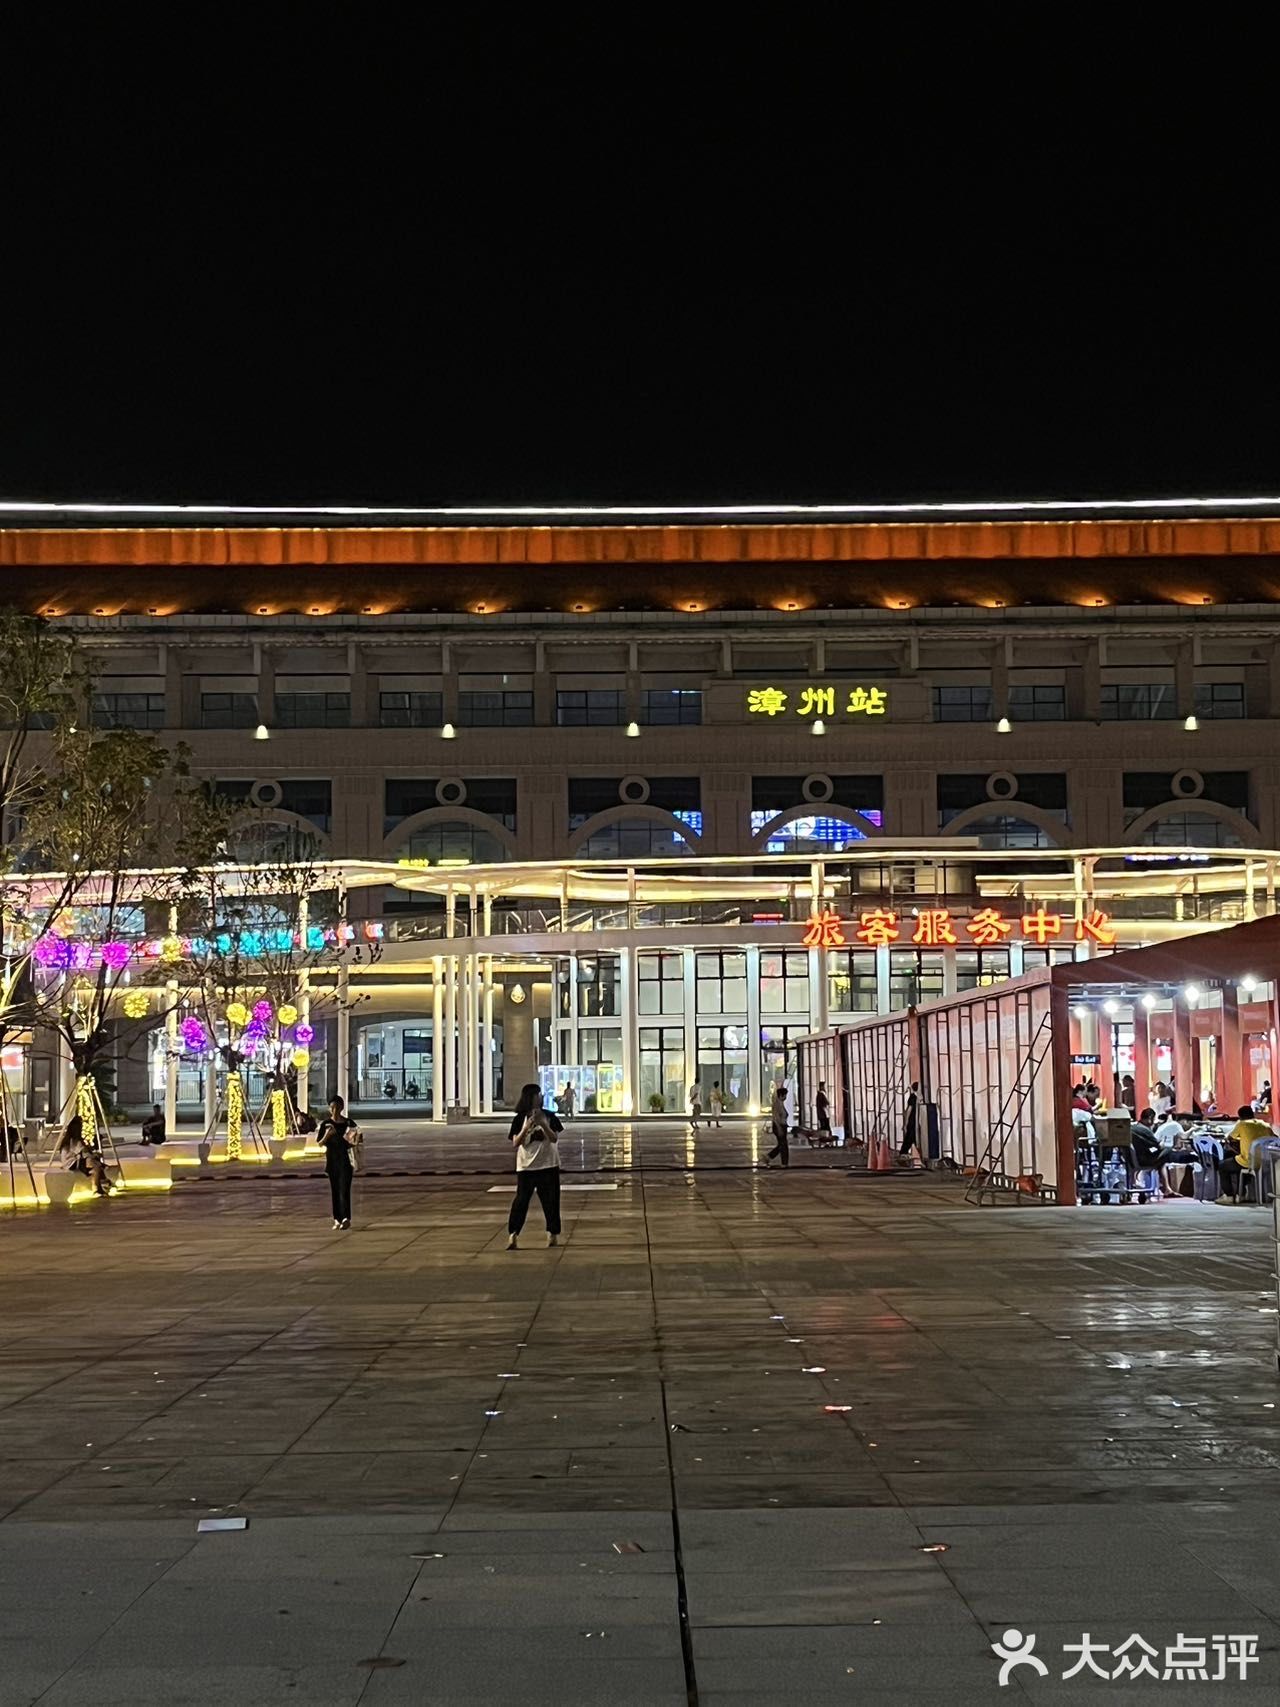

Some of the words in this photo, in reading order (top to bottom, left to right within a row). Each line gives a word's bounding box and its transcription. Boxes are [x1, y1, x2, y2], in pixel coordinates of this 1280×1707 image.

[747, 687, 888, 716] 漳州站
[802, 908, 1117, 945] 旅客服务中心
